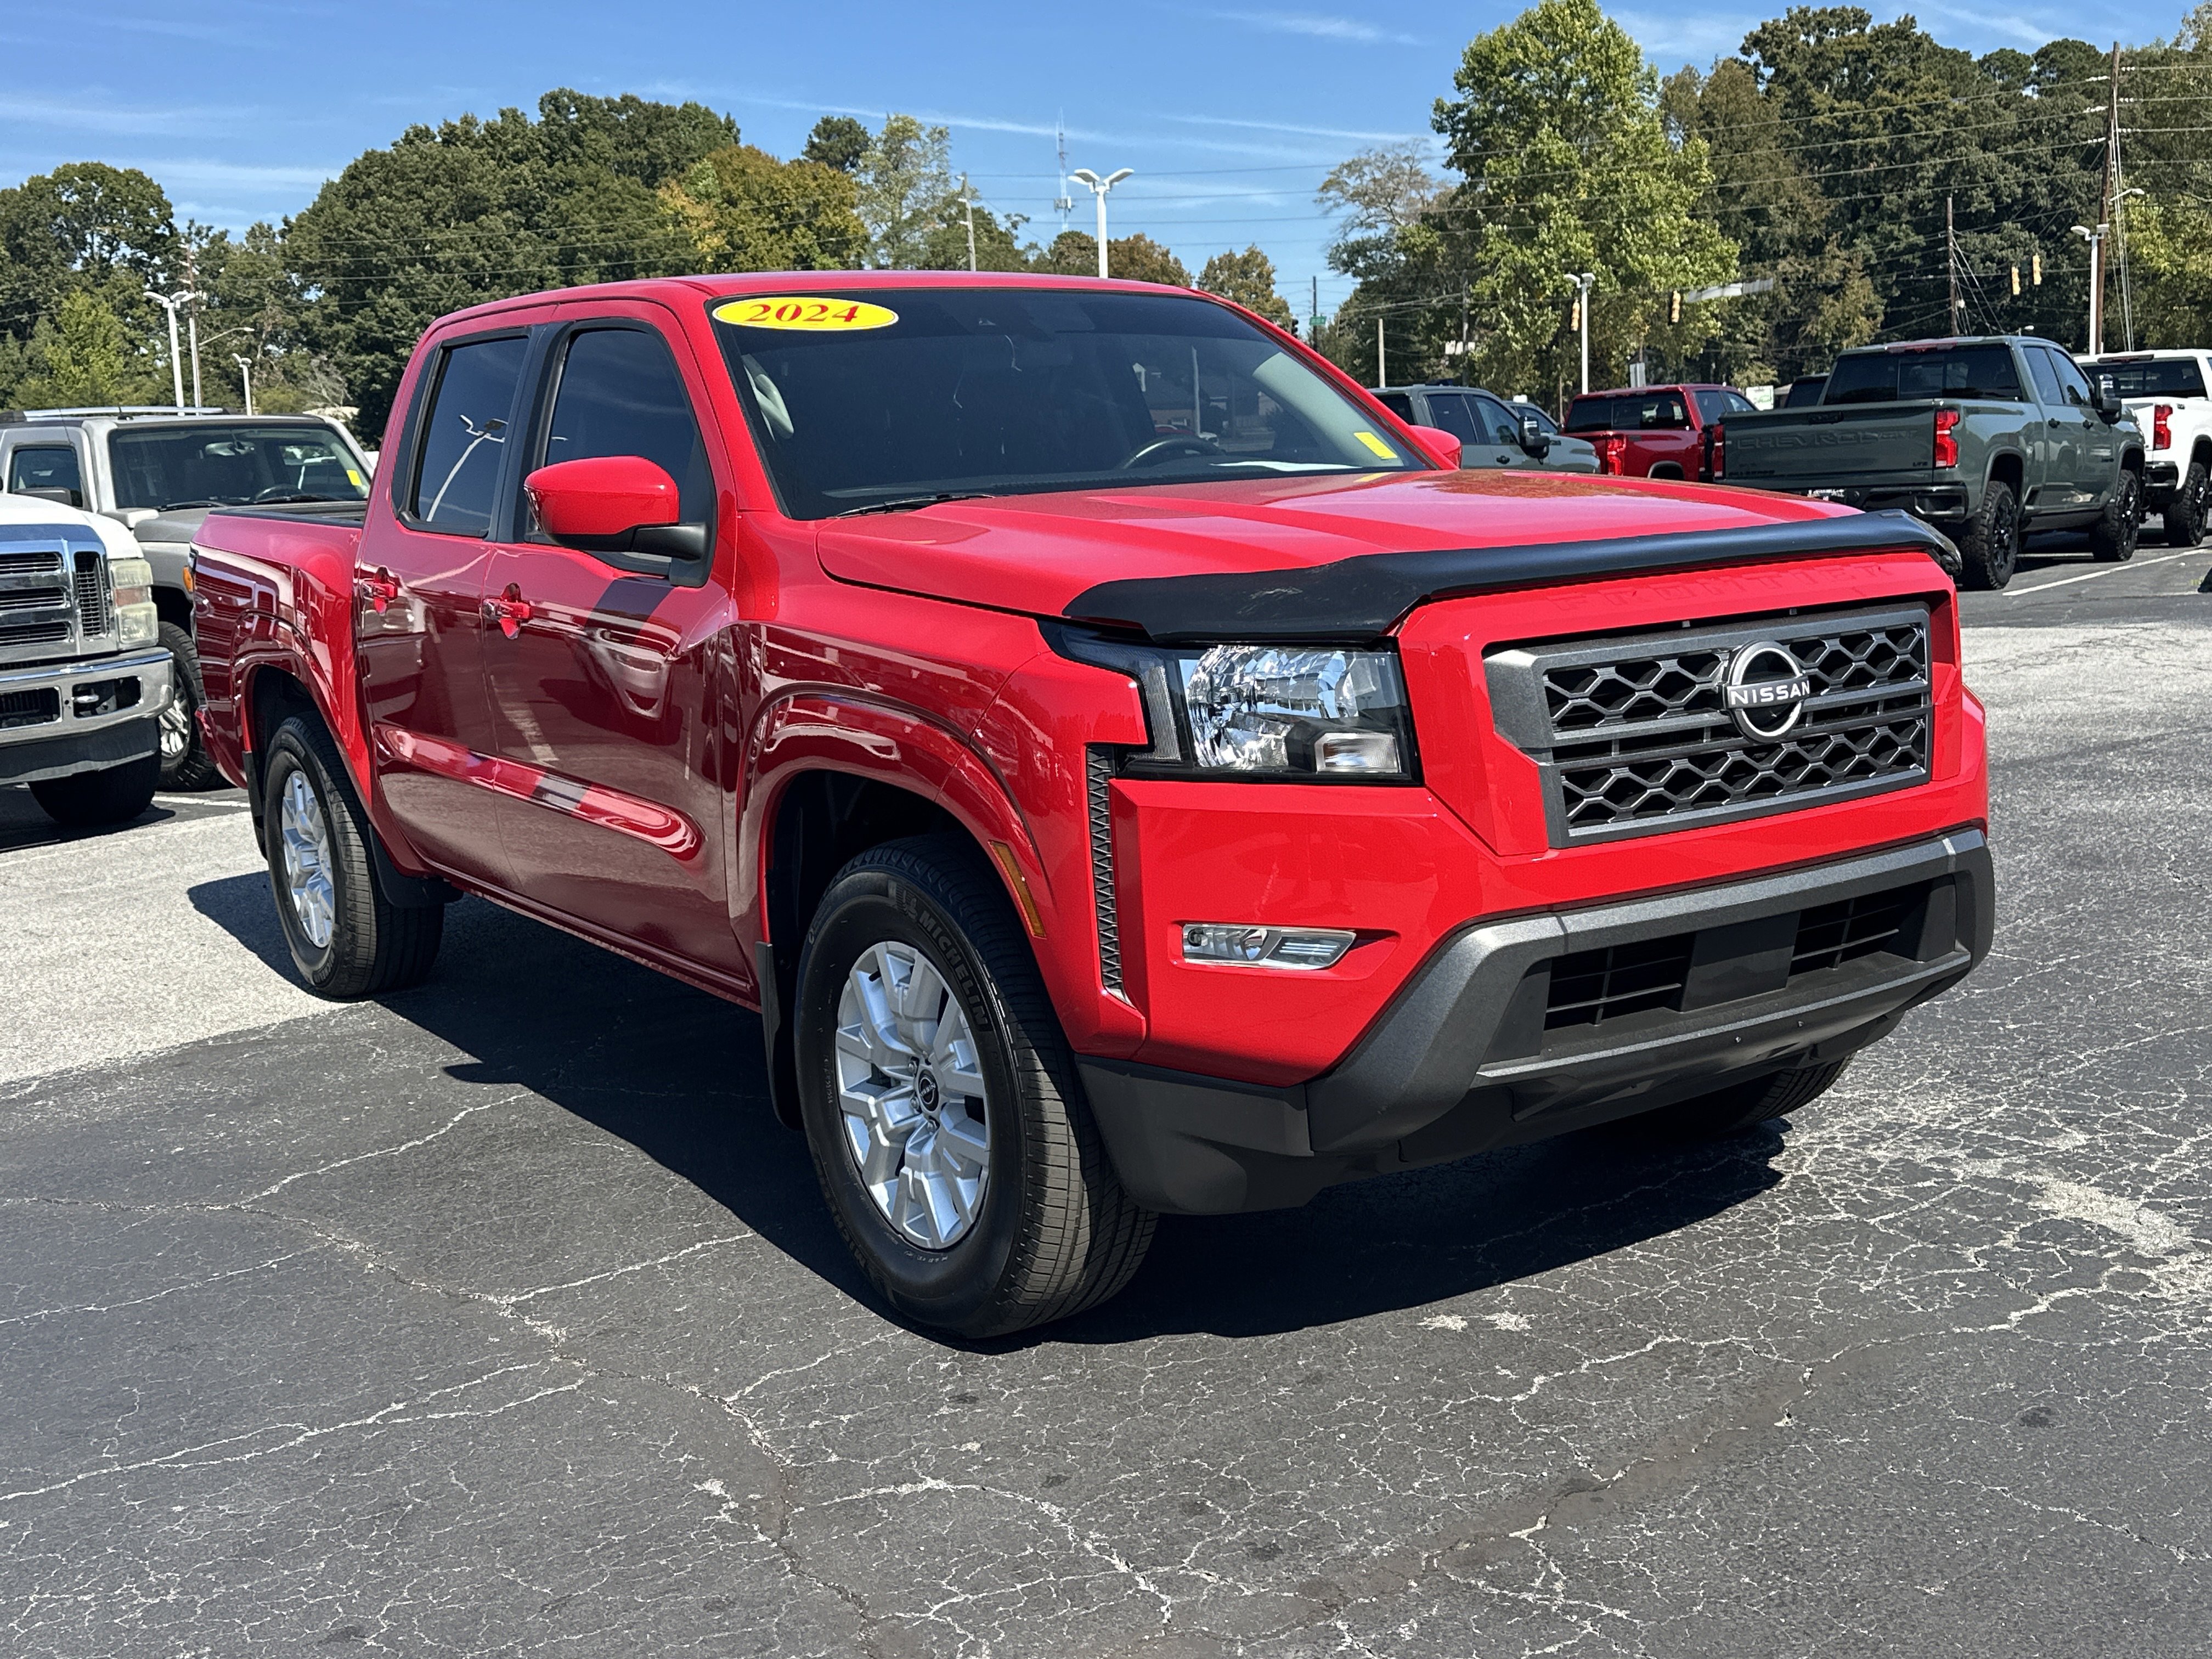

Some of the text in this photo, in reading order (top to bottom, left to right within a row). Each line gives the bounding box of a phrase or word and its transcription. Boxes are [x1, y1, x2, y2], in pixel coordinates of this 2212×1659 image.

[744, 303, 860, 323] 2024
[1736, 430, 1918, 450] CHEVROLET
[1546, 561, 1893, 611] FRONTIER
[1730, 680, 1810, 706] NISSAN
[919, 910, 988, 1025] MICHELIN
